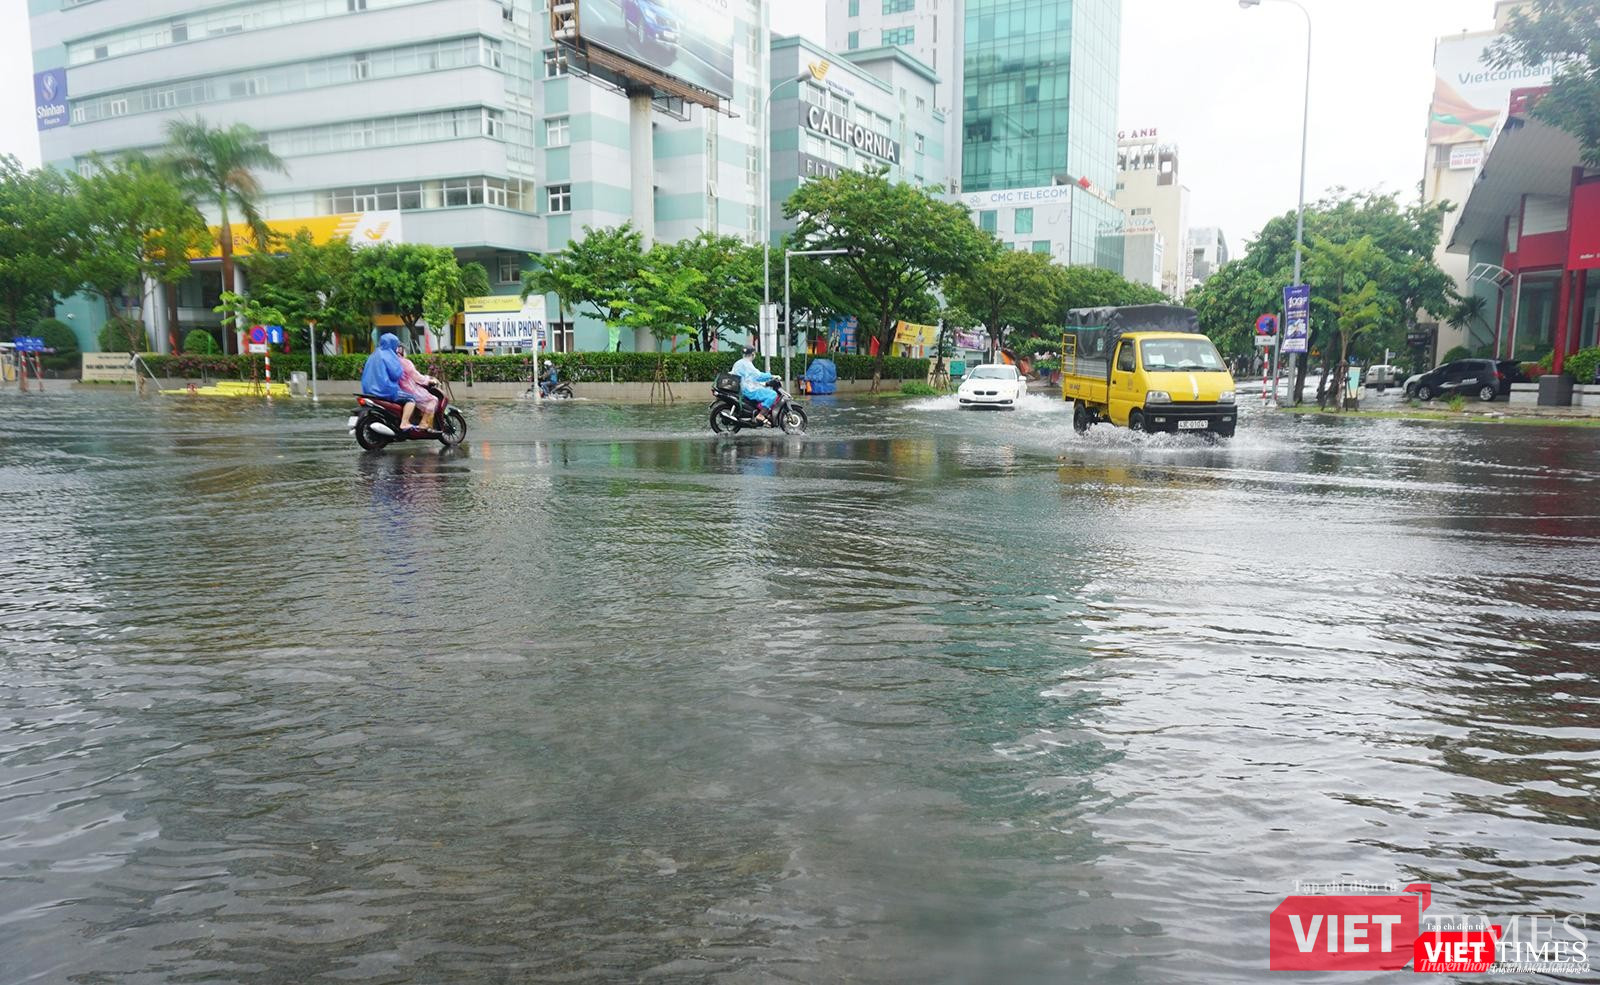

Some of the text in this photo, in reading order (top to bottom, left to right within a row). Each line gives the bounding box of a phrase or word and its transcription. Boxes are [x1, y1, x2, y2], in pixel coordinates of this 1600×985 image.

[808, 105, 896, 162] CALIFORNIA
[1131, 128, 1157, 138] ANH
[807, 159, 841, 181] FITN
[990, 187, 1068, 203] CMC TELECOM
[484, 317, 501, 338] THUÊ
